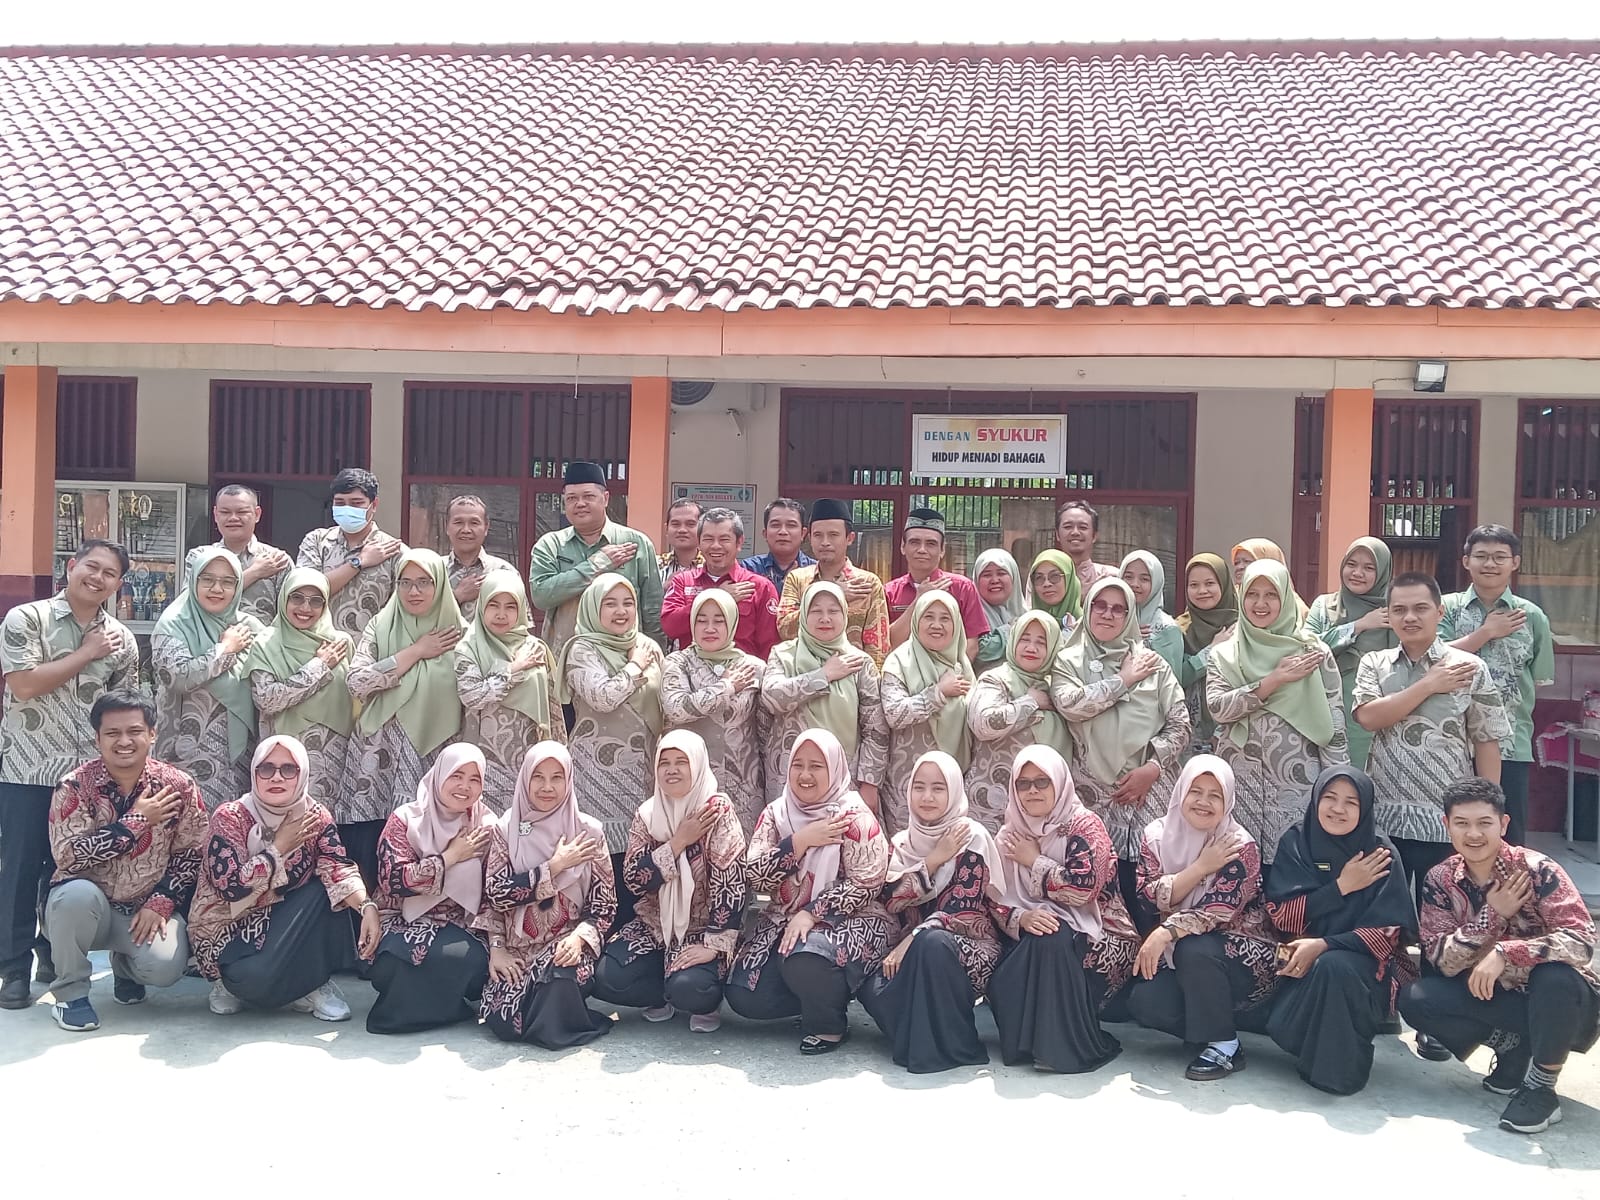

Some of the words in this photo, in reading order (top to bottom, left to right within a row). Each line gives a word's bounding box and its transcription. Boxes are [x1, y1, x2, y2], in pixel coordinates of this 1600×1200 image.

[924, 431, 970, 441] DENGAN
[977, 428, 1047, 442] SYUKUR
[932, 452, 959, 462] HIDUP
[962, 452, 1000, 463] MENJADI
[1003, 453, 1045, 464] BAHAGIA
